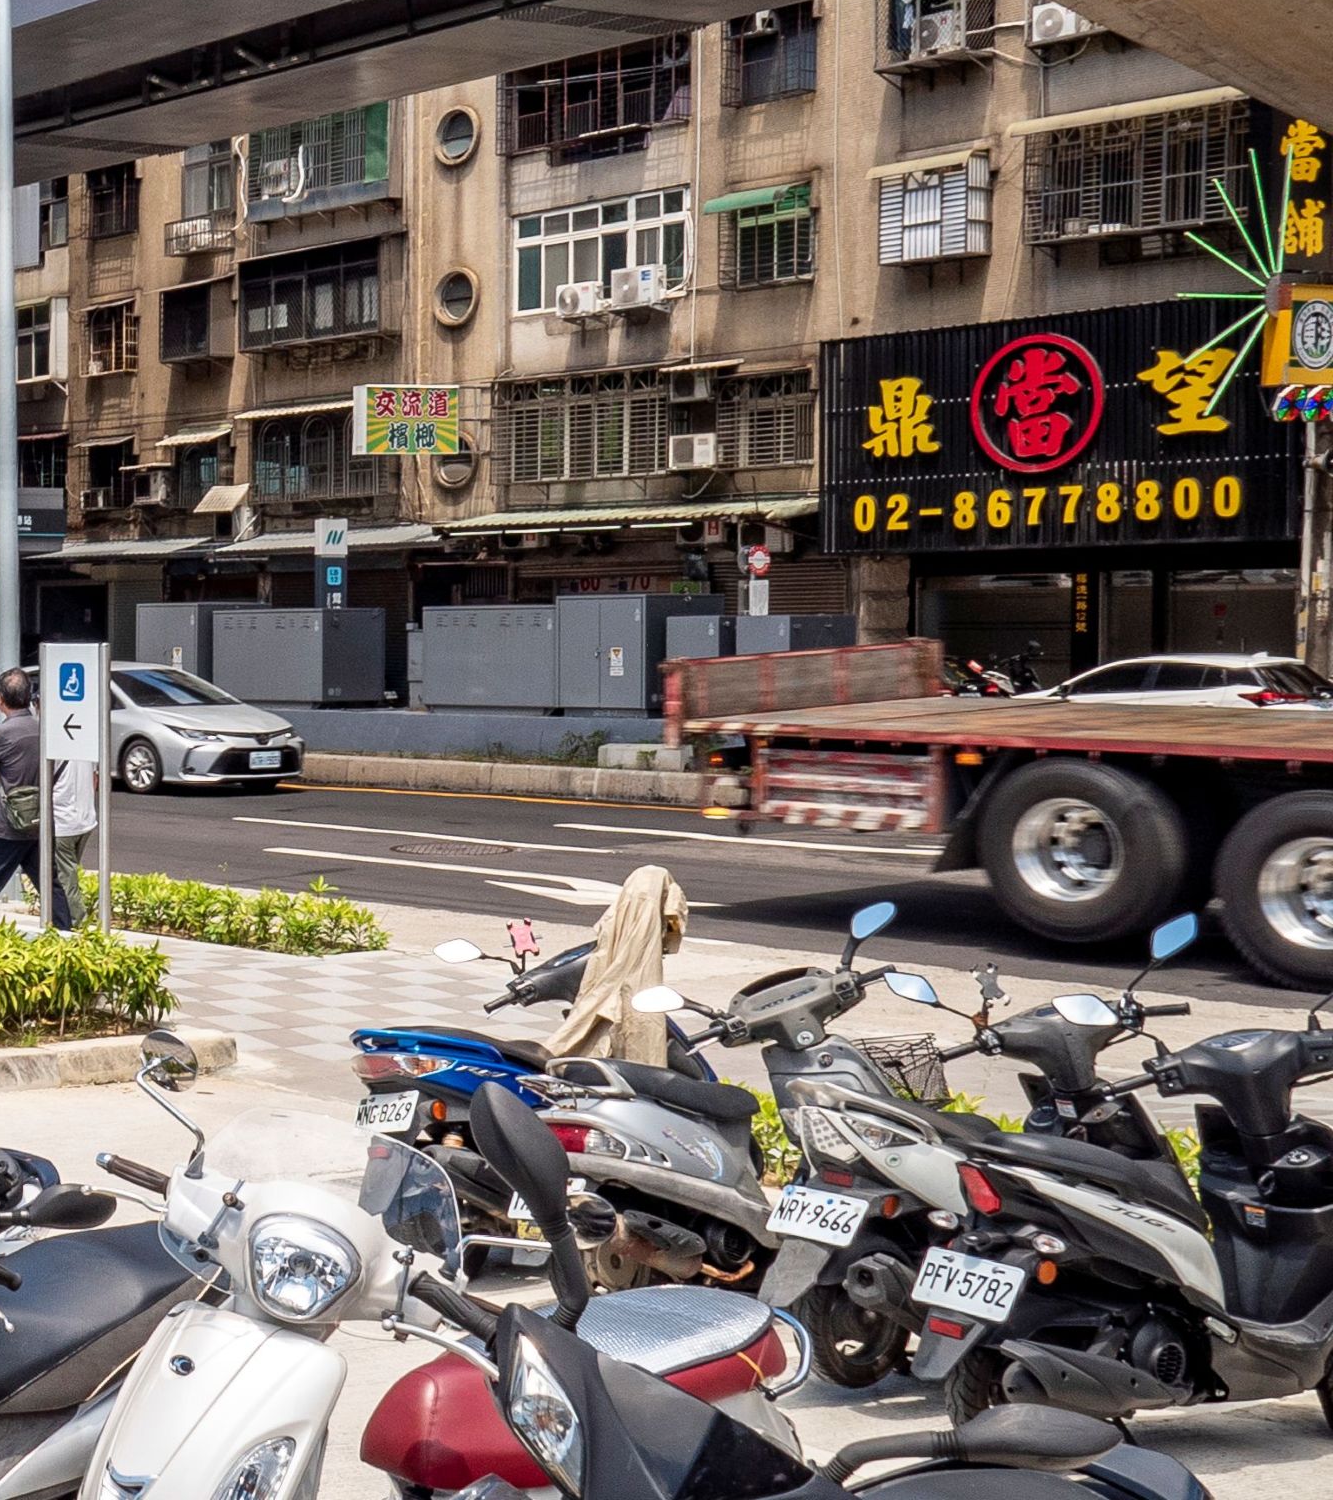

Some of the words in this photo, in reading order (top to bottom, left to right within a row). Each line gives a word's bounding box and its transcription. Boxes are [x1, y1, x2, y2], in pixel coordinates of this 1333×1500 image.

[375, 389, 448, 417] 交流道
[388, 422, 436, 449] 檳榔
[853, 476, 1242, 533] 02-86778800
